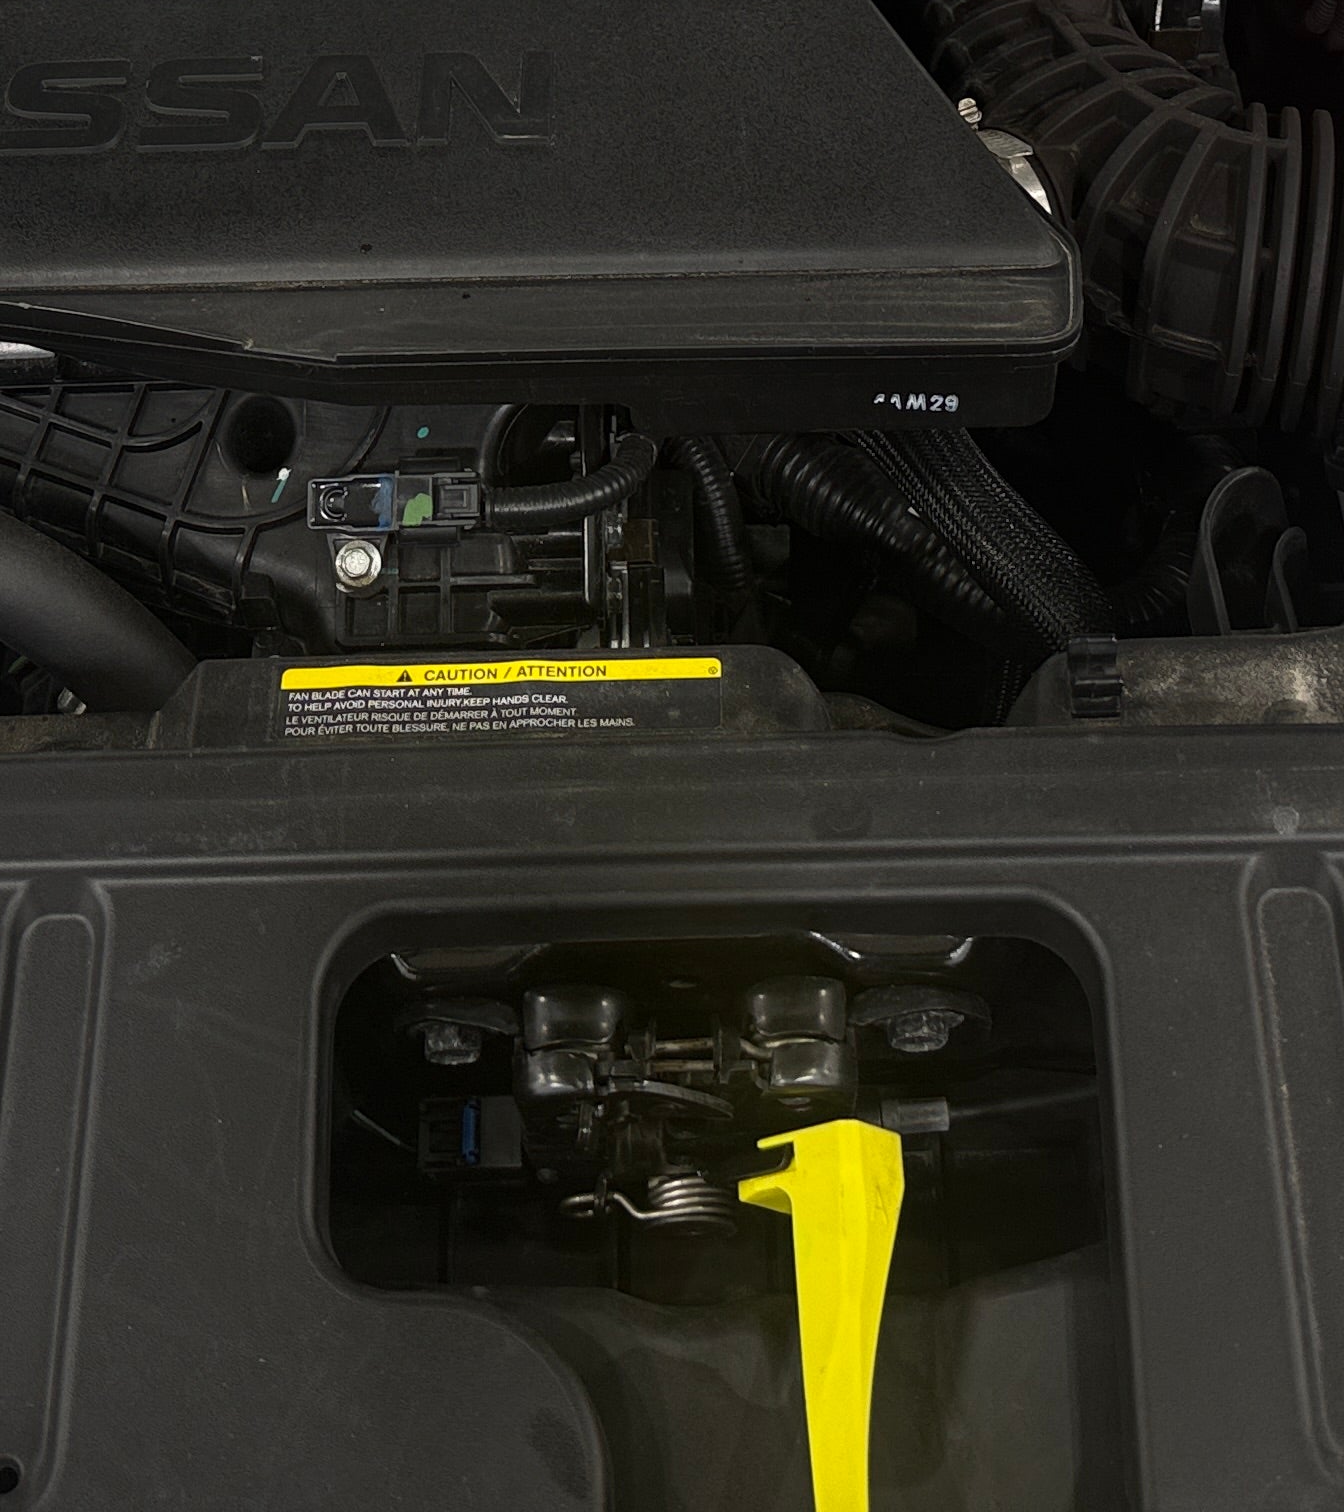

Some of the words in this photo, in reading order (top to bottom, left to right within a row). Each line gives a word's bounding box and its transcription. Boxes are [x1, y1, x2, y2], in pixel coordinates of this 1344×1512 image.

[424, 668, 498, 681] CAUTION
[504, 666, 511, 679] /
[517, 665, 607, 678] ATTENTION
[288, 692, 310, 701] FAN
[311, 690, 345, 700] BLADE
[347, 688, 370, 698] CAN
[373, 688, 406, 697] START
[407, 687, 420, 697] AT
[422, 687, 444, 697] ANY
[446, 687, 472, 696] TIME.
[288, 702, 302, 712] TO
[304, 701, 332, 711] HELP
[333, 700, 365, 710] AVOID
[367, 698, 424, 709] PERSONAL
[492, 695, 529, 705] HANDS
[532, 694, 568, 704] CLEAR.
[285, 716, 299, 725] LE
[301, 712, 368, 724] VENTILATEUR
[371, 711, 411, 722] RISQUE
[413, 711, 427, 721] DE
[430, 708, 488, 720] DÉMARRER
[491, 707, 499, 718] À
[500, 707, 527, 717] TOUT
[285, 726, 316, 736] POUR
[317, 723, 353, 735] ÉVITER
[356, 723, 390, 733] TOUTE
[392, 722, 450, 734] BLESSURE,
[452, 721, 467, 731] NE
[469, 721, 490, 731] PAS
[492, 719, 506, 730] EN
[509, 717, 575, 729] APPROCHER
[578, 718, 598, 728] LES
[599, 717, 635, 727] MAINS.
